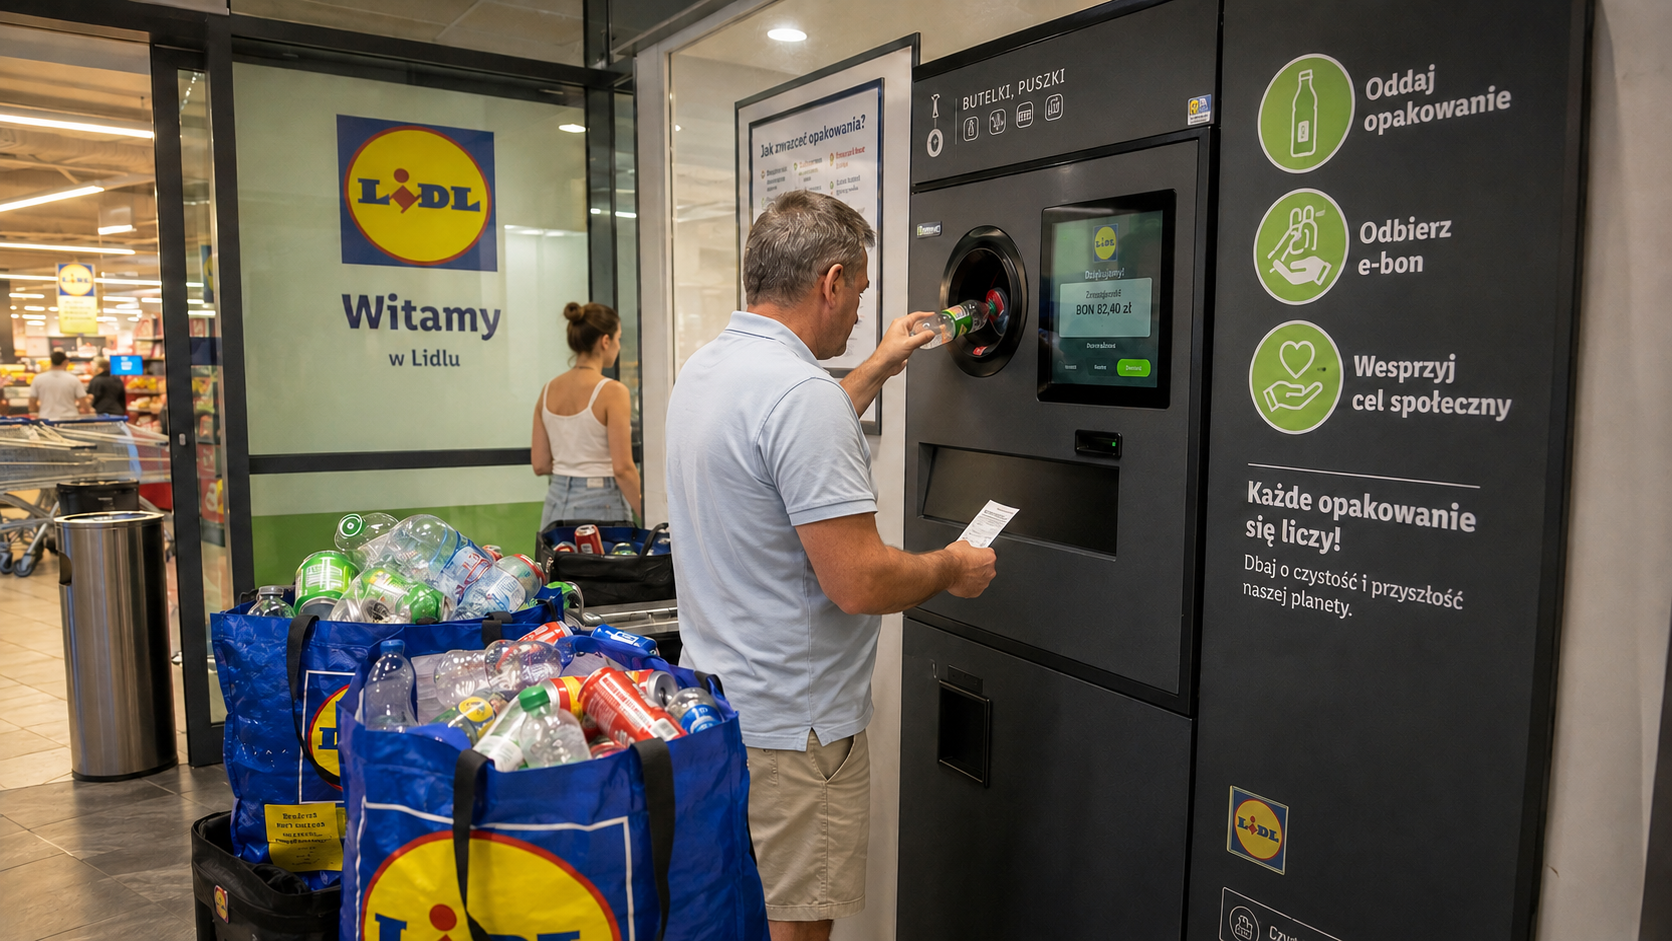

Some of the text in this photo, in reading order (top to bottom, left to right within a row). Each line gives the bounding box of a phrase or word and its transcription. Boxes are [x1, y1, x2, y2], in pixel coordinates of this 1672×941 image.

[963, 68, 1065, 111] BUTELKI, PUSZKI
[1365, 63, 1435, 101] Oddaj
[1364, 85, 1511, 135] opakowanie
[760, 142, 774, 158] Jak
[808, 114, 866, 146] opakowania?
[1359, 216, 1452, 244] Odbierz
[1358, 251, 1424, 275] e-bon
[341, 293, 501, 341] Witamy
[1076, 301, 1132, 317] BON 82,40 zł
[388, 349, 461, 367] w Lidlu
[1353, 353, 1456, 384] Wesprzyj
[1352, 389, 1512, 421] cel społeczny
[1247, 480, 1476, 533] Każde opakowanie
[1245, 515, 1341, 554] się liczy!
[1243, 581, 1352, 619] naszej planety.
[1244, 554, 1463, 610] Dbaj o czystość i przyszłość
